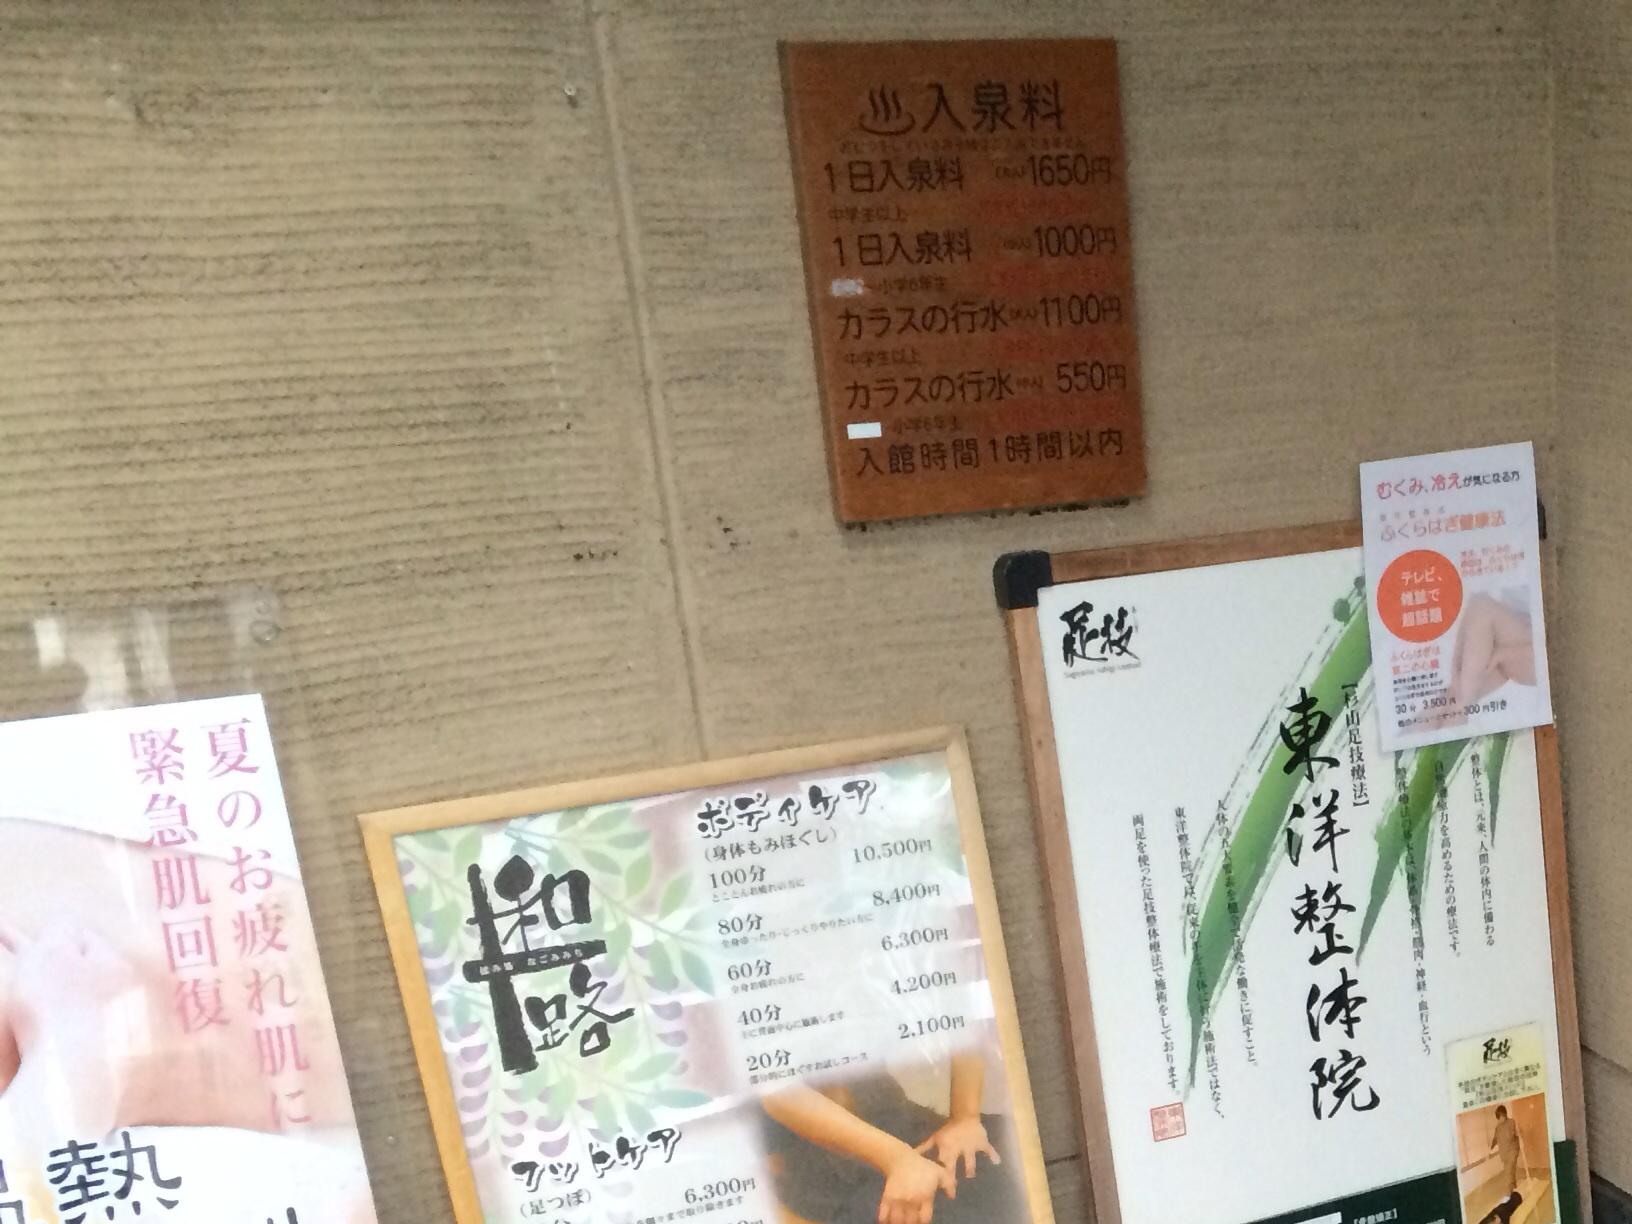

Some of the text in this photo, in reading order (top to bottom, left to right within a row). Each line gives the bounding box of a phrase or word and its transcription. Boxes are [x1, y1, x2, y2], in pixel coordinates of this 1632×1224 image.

[922, 80, 1063, 132] 入泉料
[1030, 154, 1112, 187] 1650円
[1033, 225, 1117, 258] 1000円
[839, 295, 1121, 341] カラスの行水 1100円
[846, 362, 1126, 410] カラスの行水 550円
[856, 427, 1124, 476] 入館時間1時間以内
[696, 777, 877, 838] ボディケア
[129, 727, 232, 1036] 緊急肌回復
[708, 863, 767, 891] 100分
[200, 717, 311, 1130] 夏のお疲れ肌に
[718, 911, 763, 938] 80分
[1280, 687, 1381, 1120] 東洋整体院
[726, 957, 773, 983] 60分
[737, 1002, 783, 1028] 40分
[746, 1047, 792, 1073] 20分
[512, 1127, 682, 1194] フットケア
